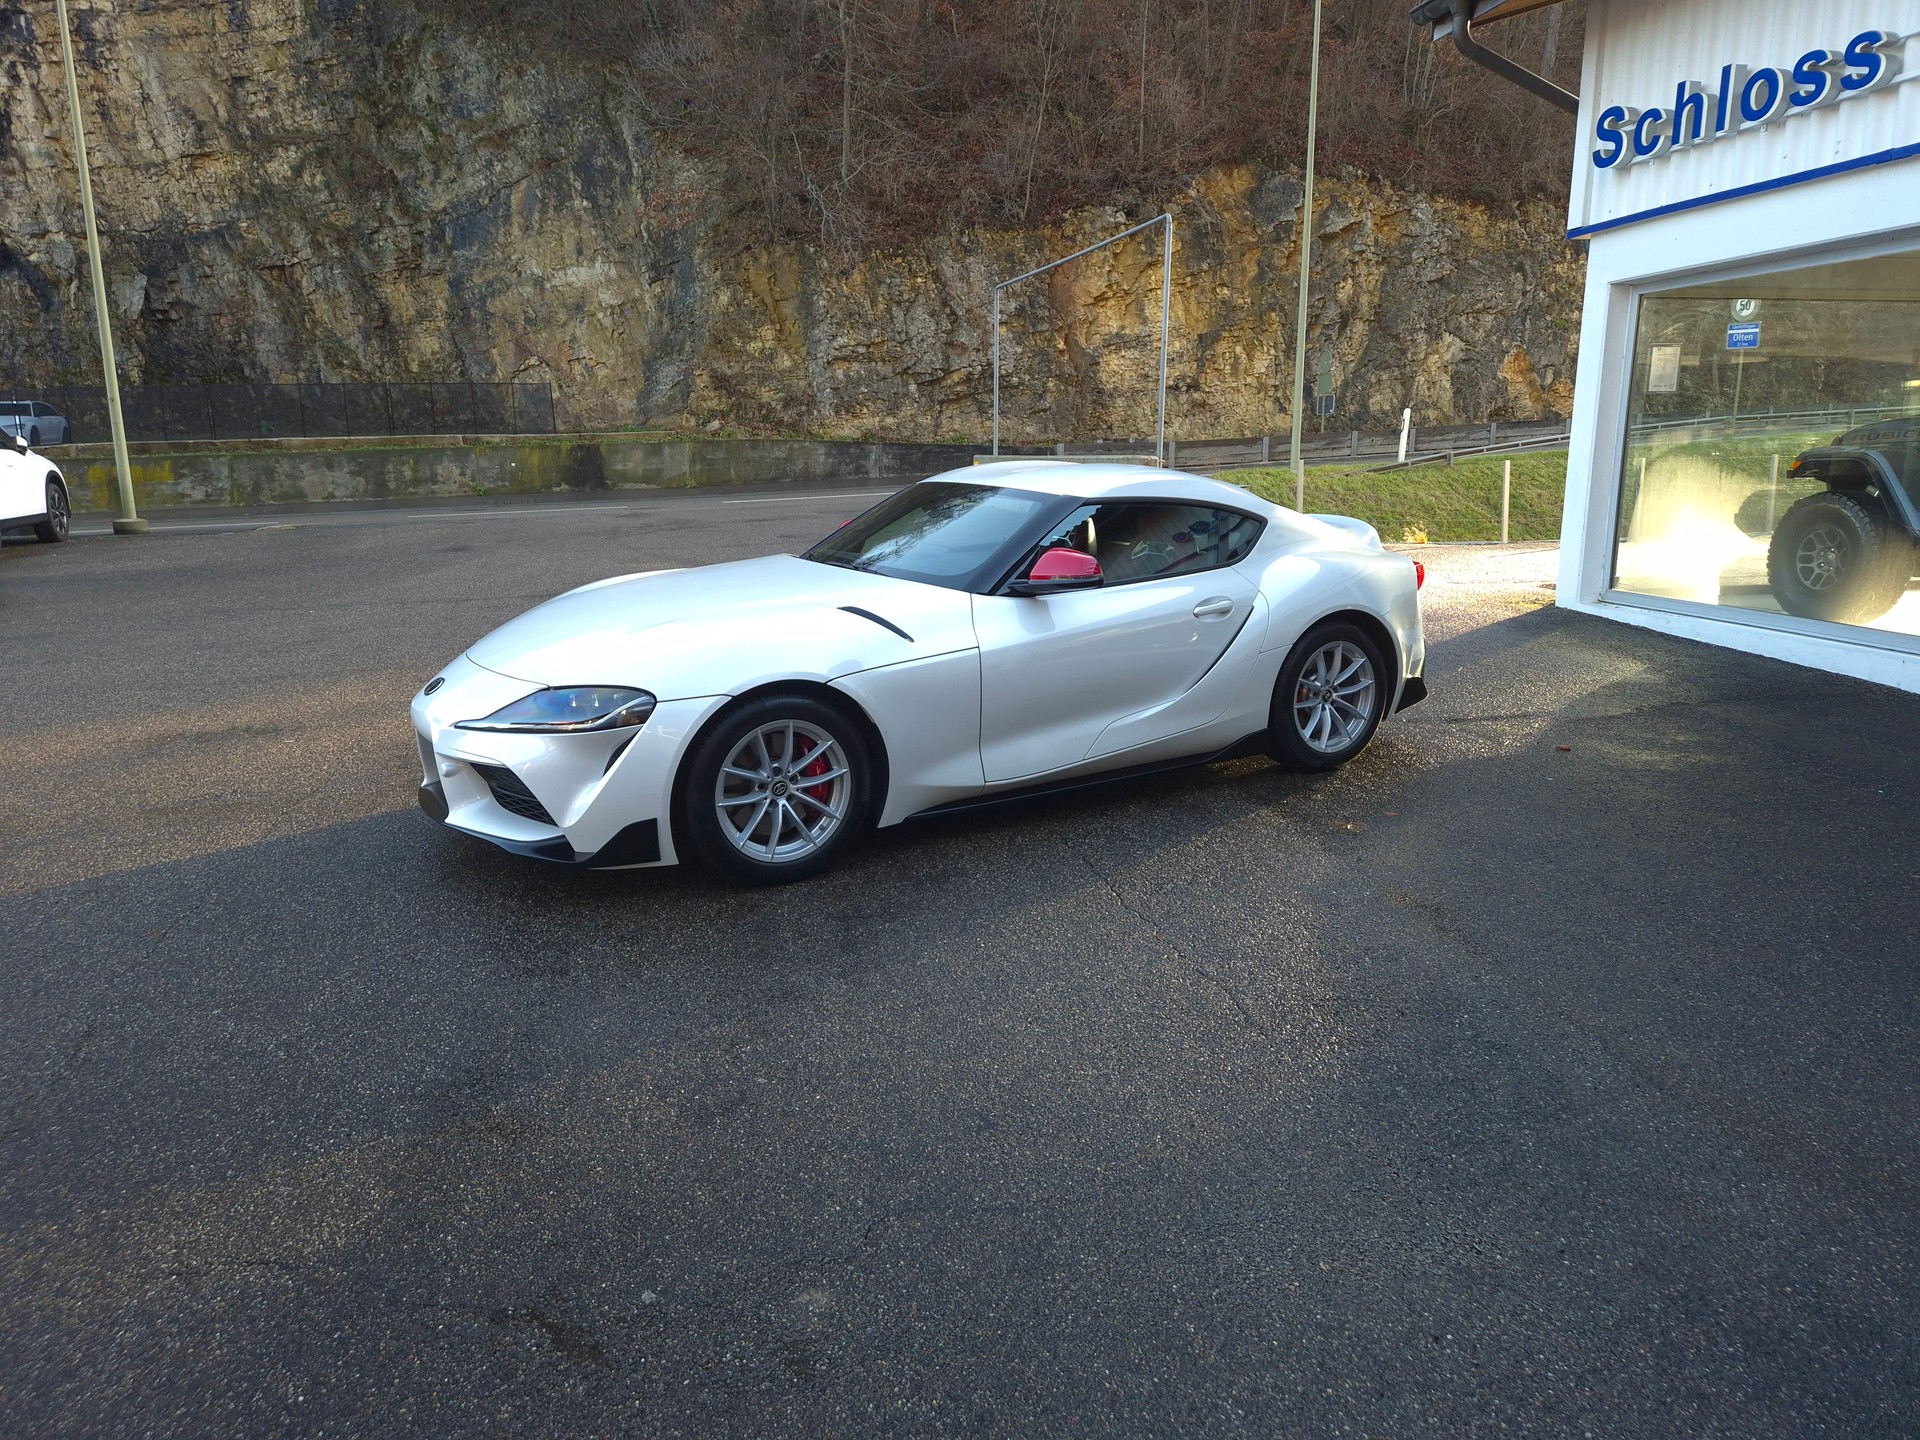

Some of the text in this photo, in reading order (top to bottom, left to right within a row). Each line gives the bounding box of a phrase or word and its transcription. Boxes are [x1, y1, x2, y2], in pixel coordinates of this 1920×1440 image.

[1592, 29, 1897, 169] Schloss
[1739, 300, 1751, 311] 50
[1733, 332, 1753, 342] Olten
